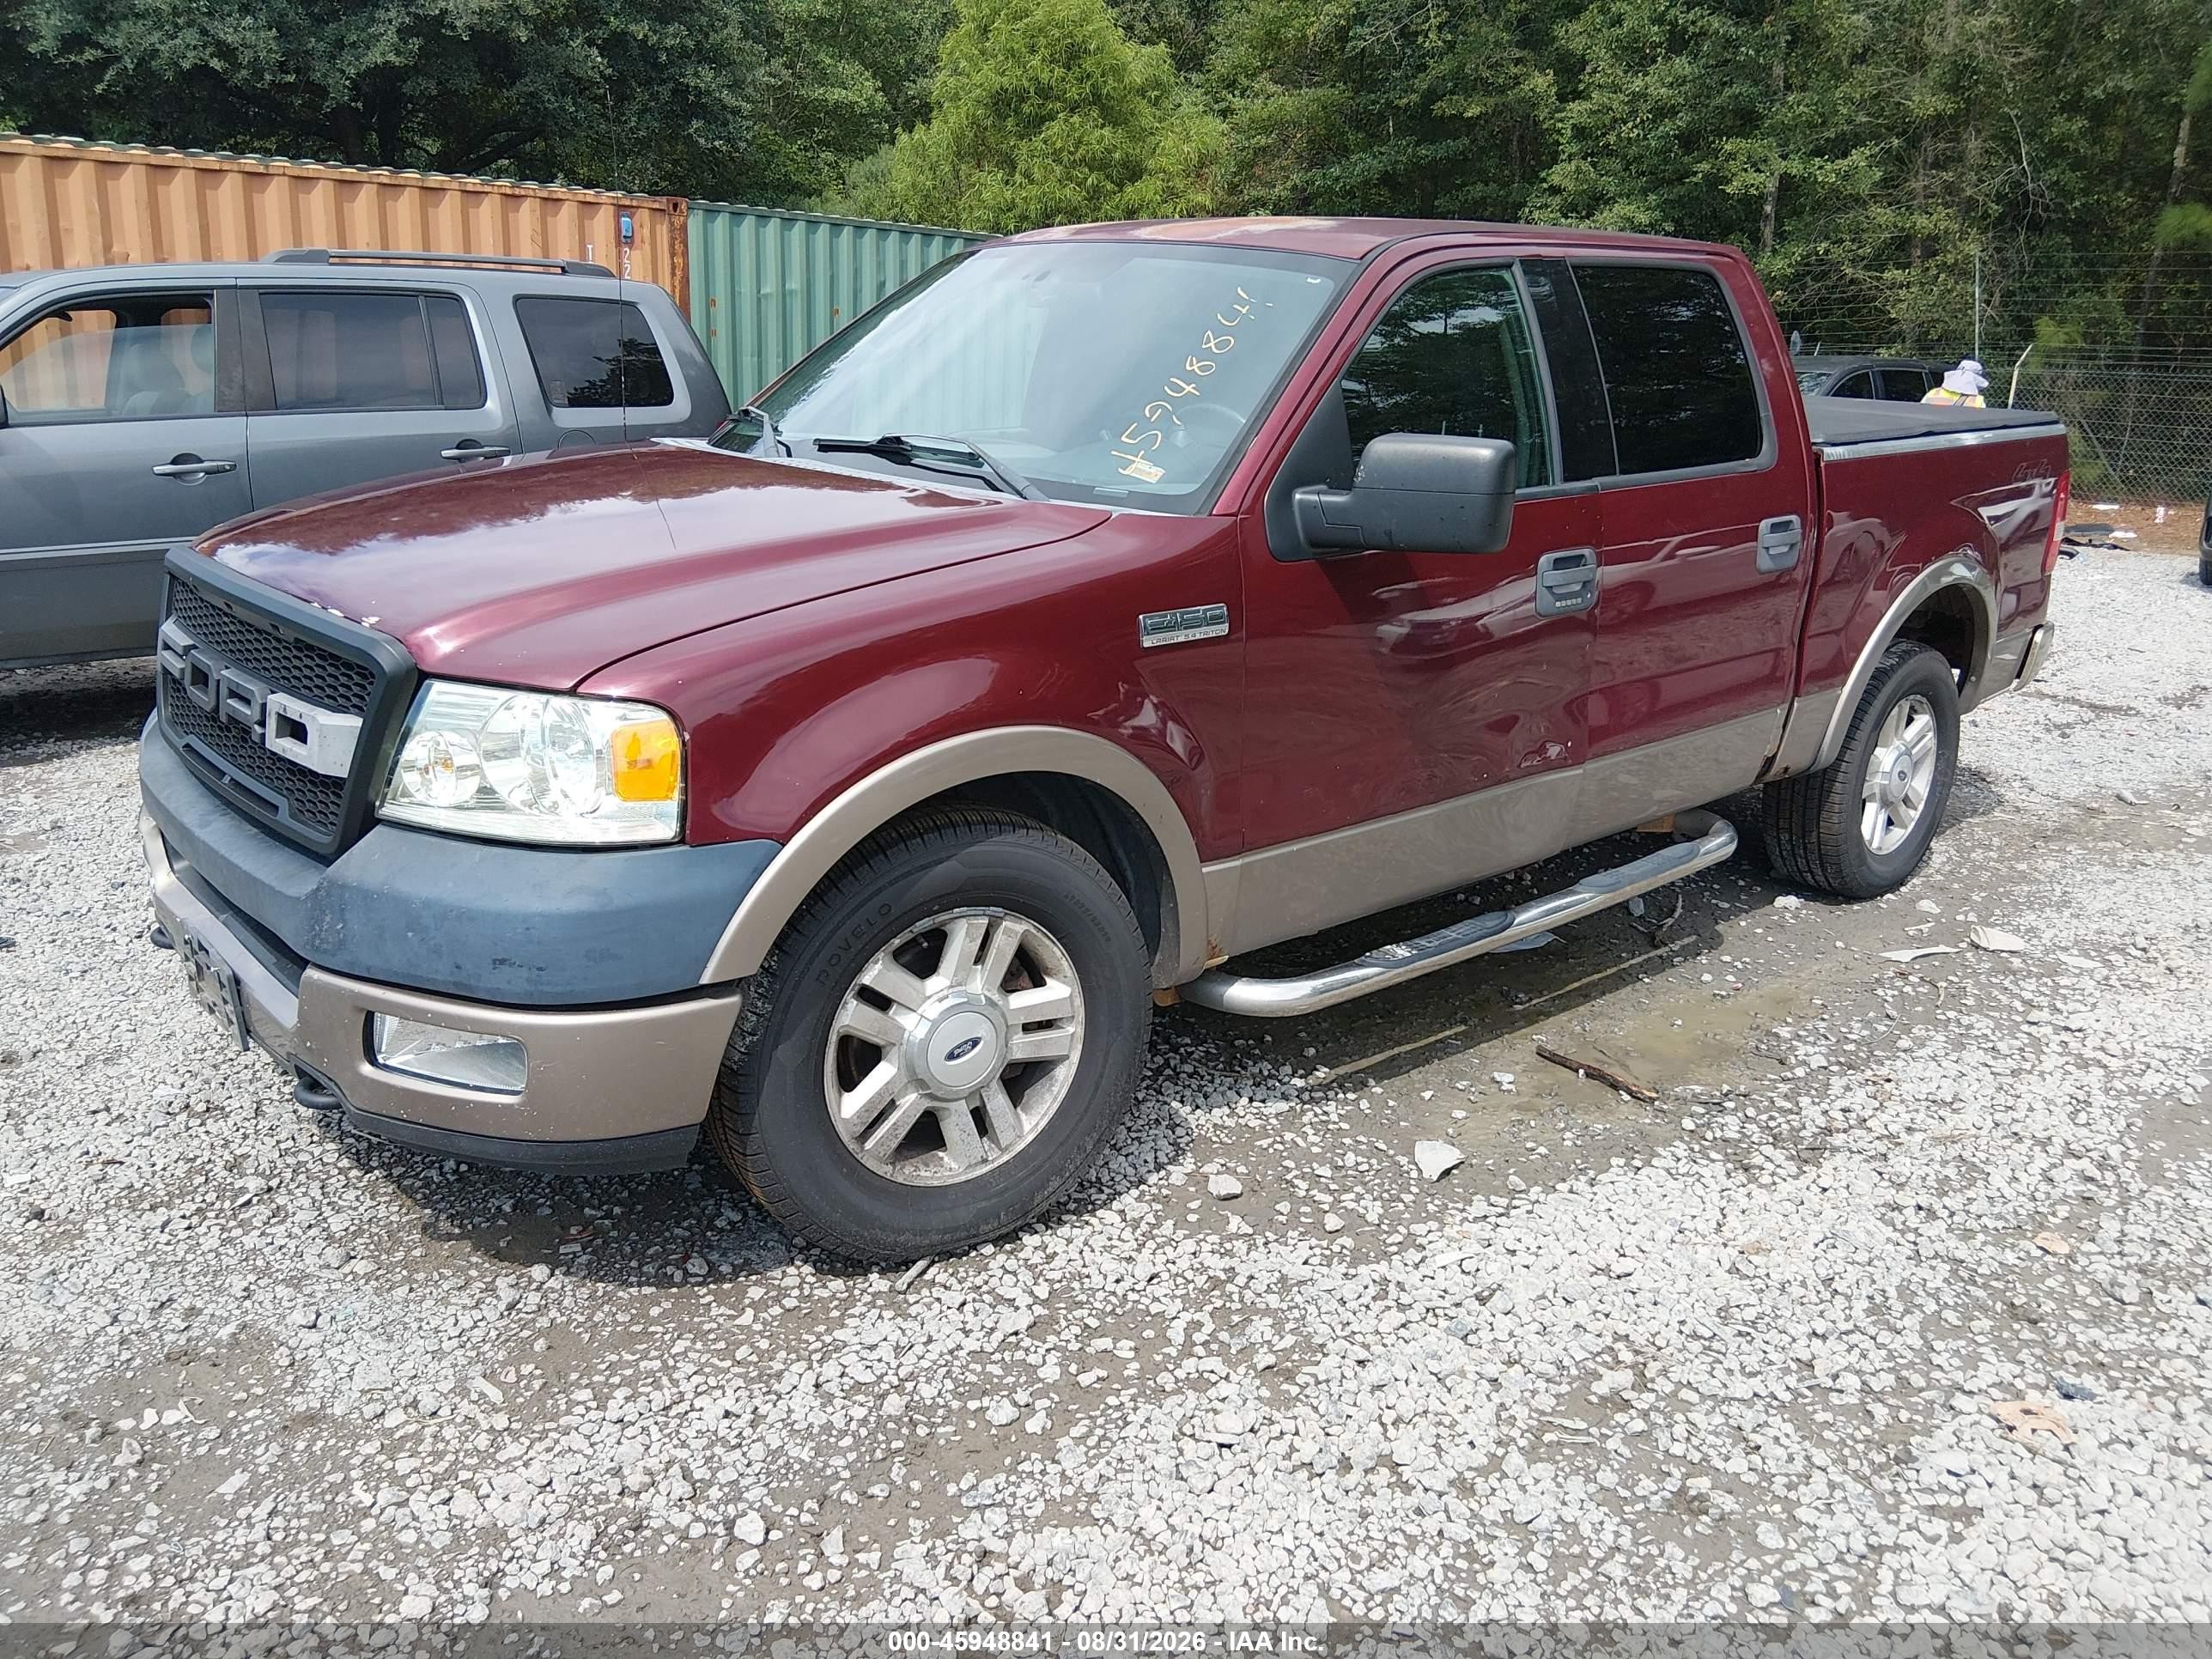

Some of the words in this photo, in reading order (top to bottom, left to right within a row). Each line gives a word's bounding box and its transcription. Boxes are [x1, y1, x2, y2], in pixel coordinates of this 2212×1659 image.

[1151, 635, 1179, 645] LARIAT
[1199, 628, 1226, 638] TRITON
[160, 616, 348, 777] FORD
